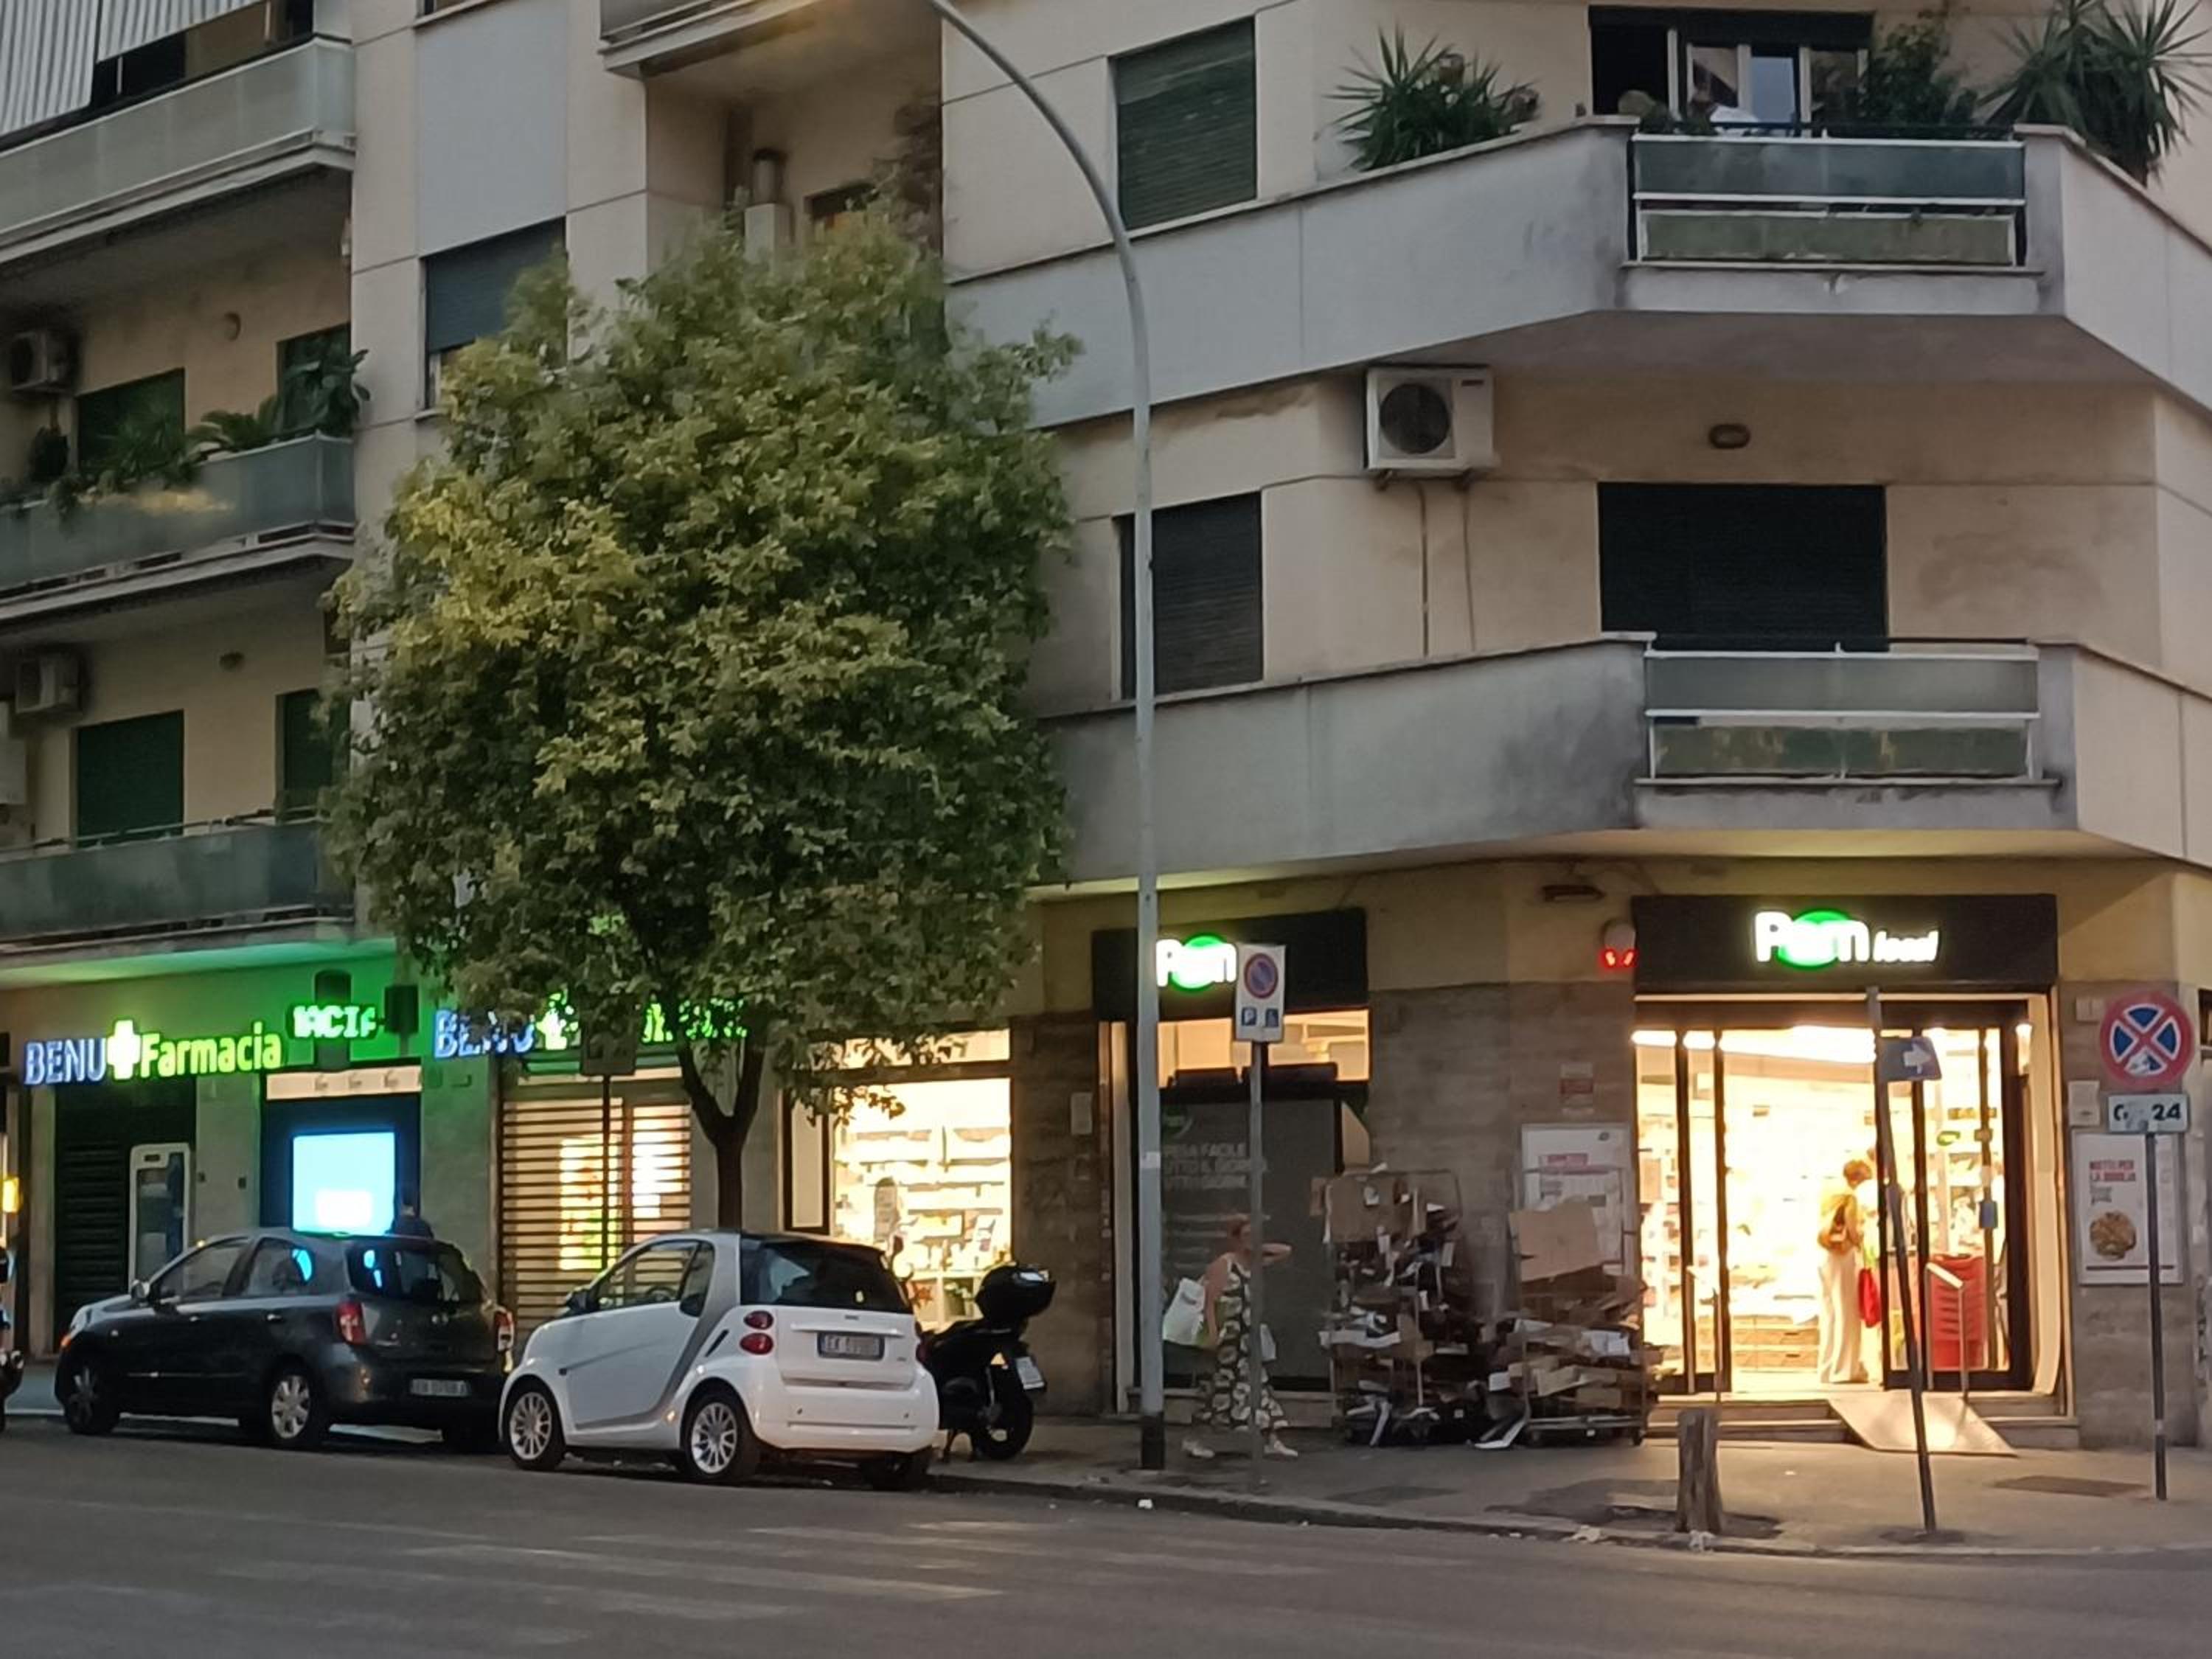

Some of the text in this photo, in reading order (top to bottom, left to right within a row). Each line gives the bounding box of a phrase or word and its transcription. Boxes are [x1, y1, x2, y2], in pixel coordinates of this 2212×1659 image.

[25, 1021, 282, 1085] BENU Farmacia
[2152, 1102, 2181, 1121] 24
